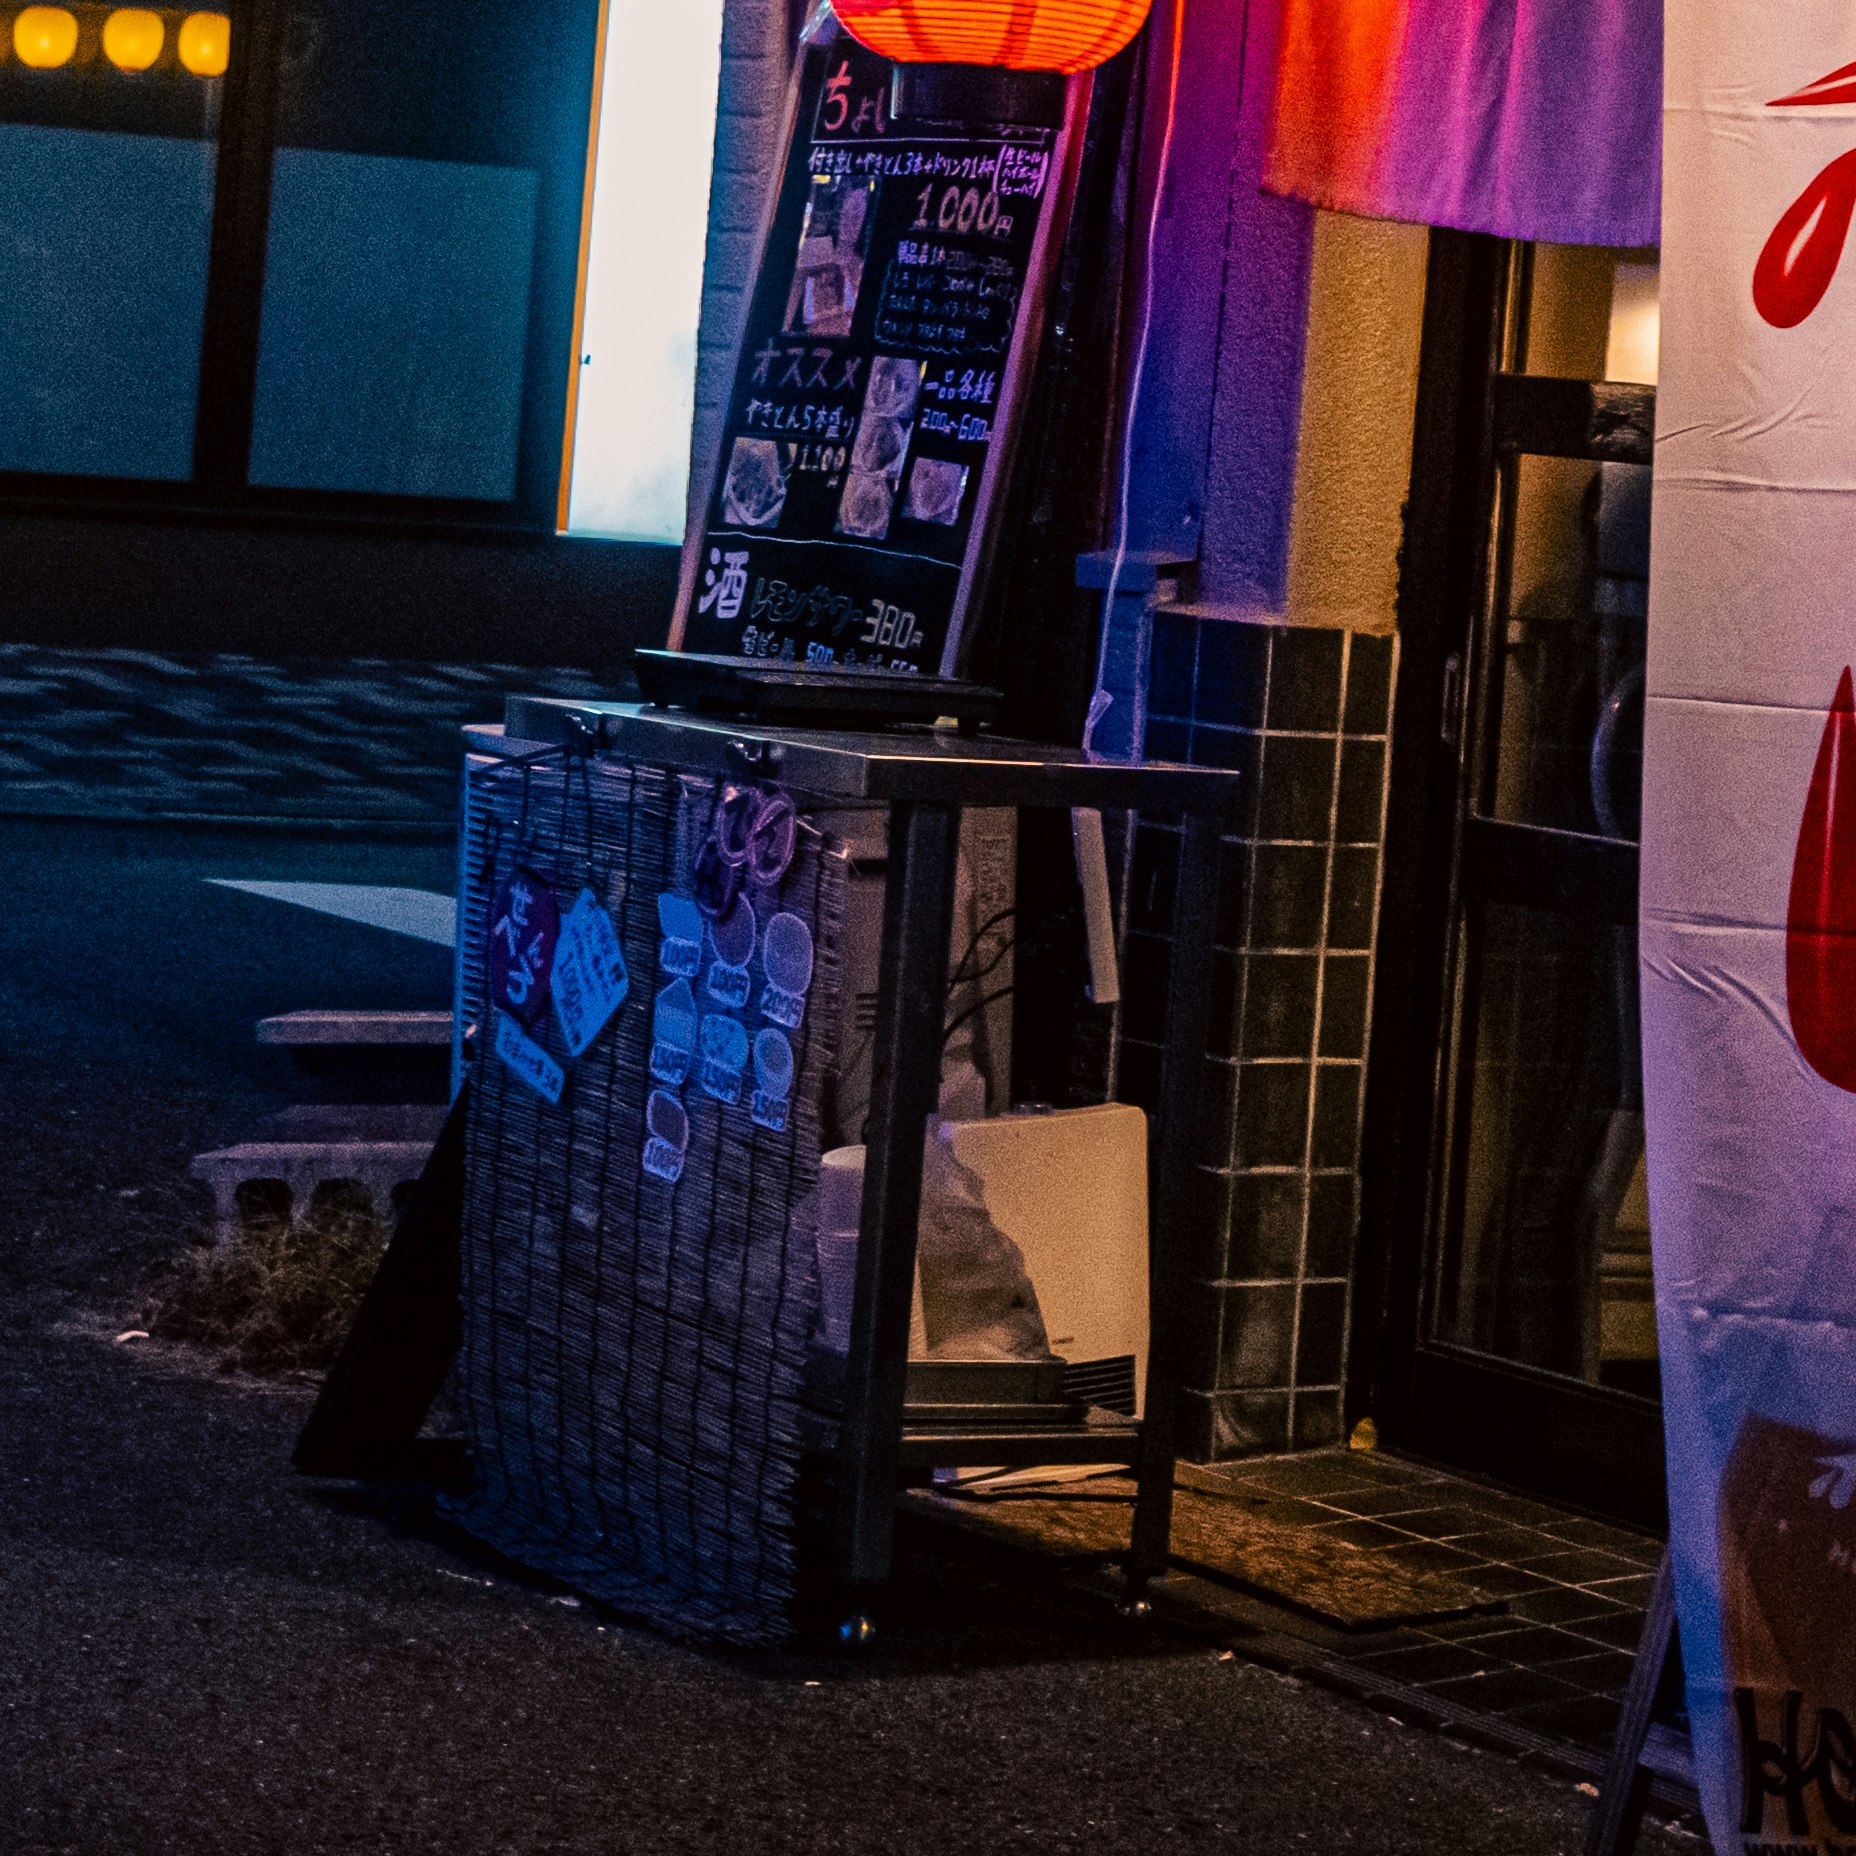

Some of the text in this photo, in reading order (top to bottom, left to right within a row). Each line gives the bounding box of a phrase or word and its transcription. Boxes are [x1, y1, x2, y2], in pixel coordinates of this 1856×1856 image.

[749, 338, 863, 390] オススメ
[924, 368, 997, 405] 一品各種
[696, 546, 750, 620] 酒
[749, 575, 864, 637] レモンサワー
